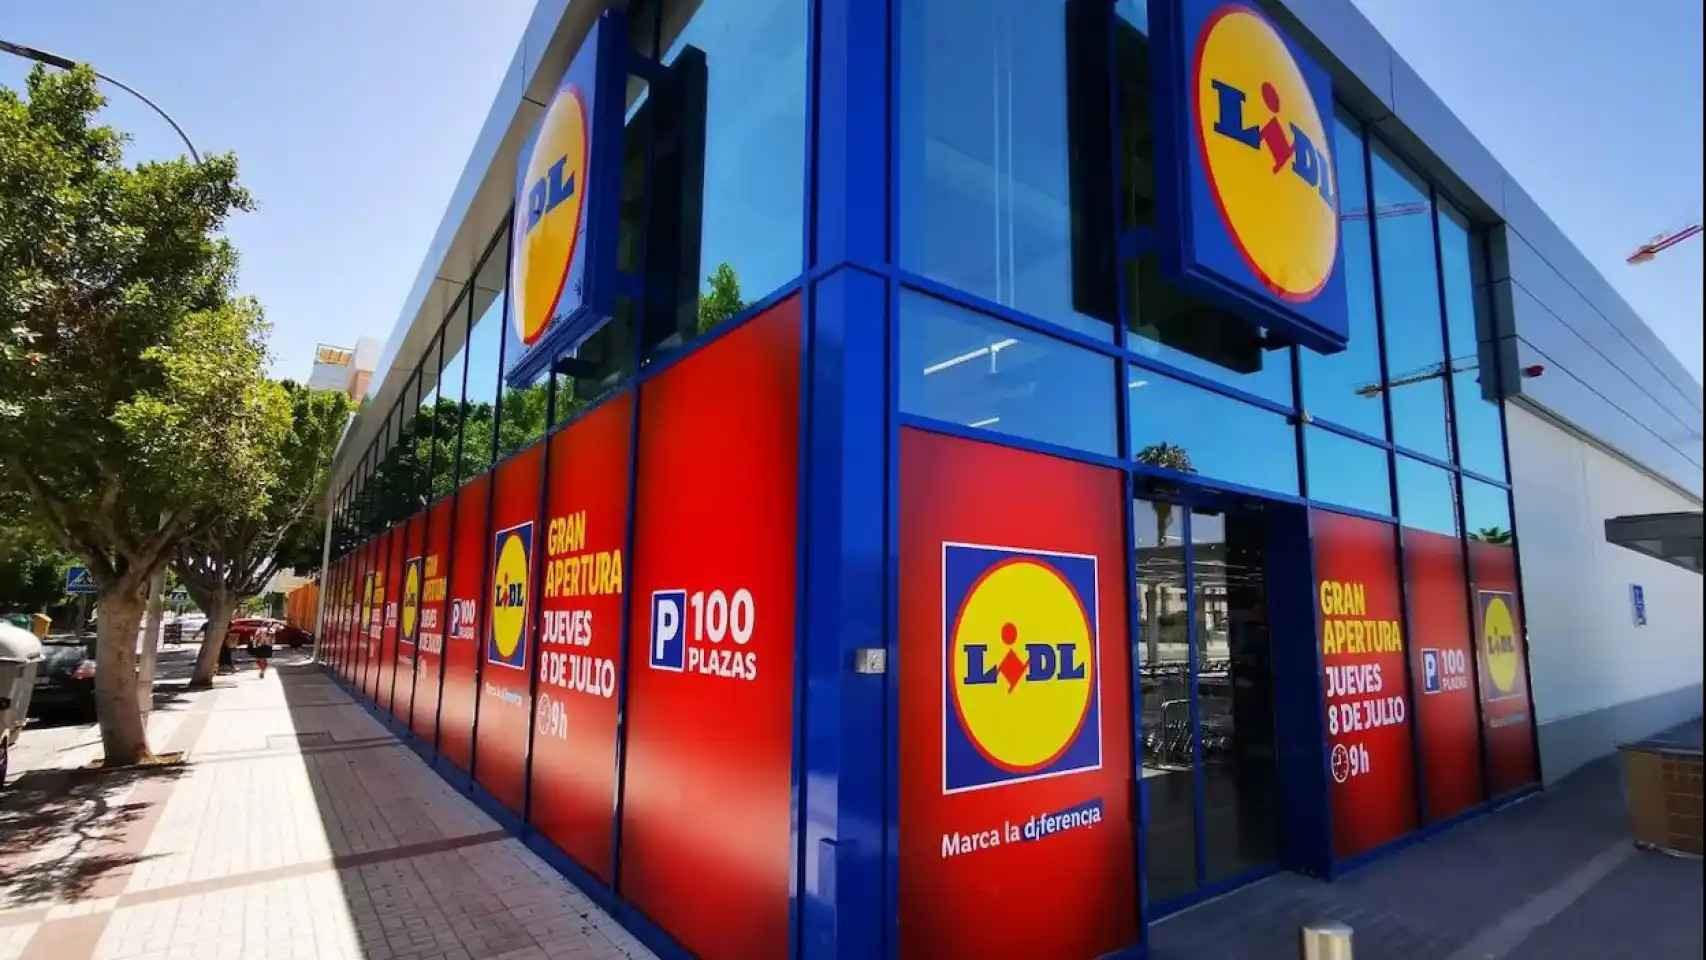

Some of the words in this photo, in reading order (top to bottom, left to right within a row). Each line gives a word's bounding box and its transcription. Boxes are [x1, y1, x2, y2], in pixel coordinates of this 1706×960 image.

[527, 153, 575, 235] DL
[549, 511, 585, 555] GRAN
[545, 549, 622, 598] APERTURA
[691, 588, 755, 645] 100
[1320, 580, 1366, 616] GRAN
[542, 610, 592, 646] JUEVES
[656, 600, 679, 660] P
[1323, 620, 1402, 654] APERTURA
[541, 651, 549, 682] 8
[550, 652, 567, 687] DE
[568, 654, 615, 698] JULIO
[688, 647, 757, 681] PLAZAS
[1326, 663, 1382, 697] JUEVES
[1425, 653, 1436, 689] P
[1441, 649, 1465, 674] 100
[551, 701, 568, 740] 9h
[1328, 705, 1338, 735] 8
[1342, 701, 1362, 734] DE
[1364, 696, 1405, 729] JULIO
[1350, 743, 1370, 776] 9h
[941, 829, 1000, 858] Marca
[1004, 821, 1020, 844] la
[1024, 807, 1101, 841] diferencia
